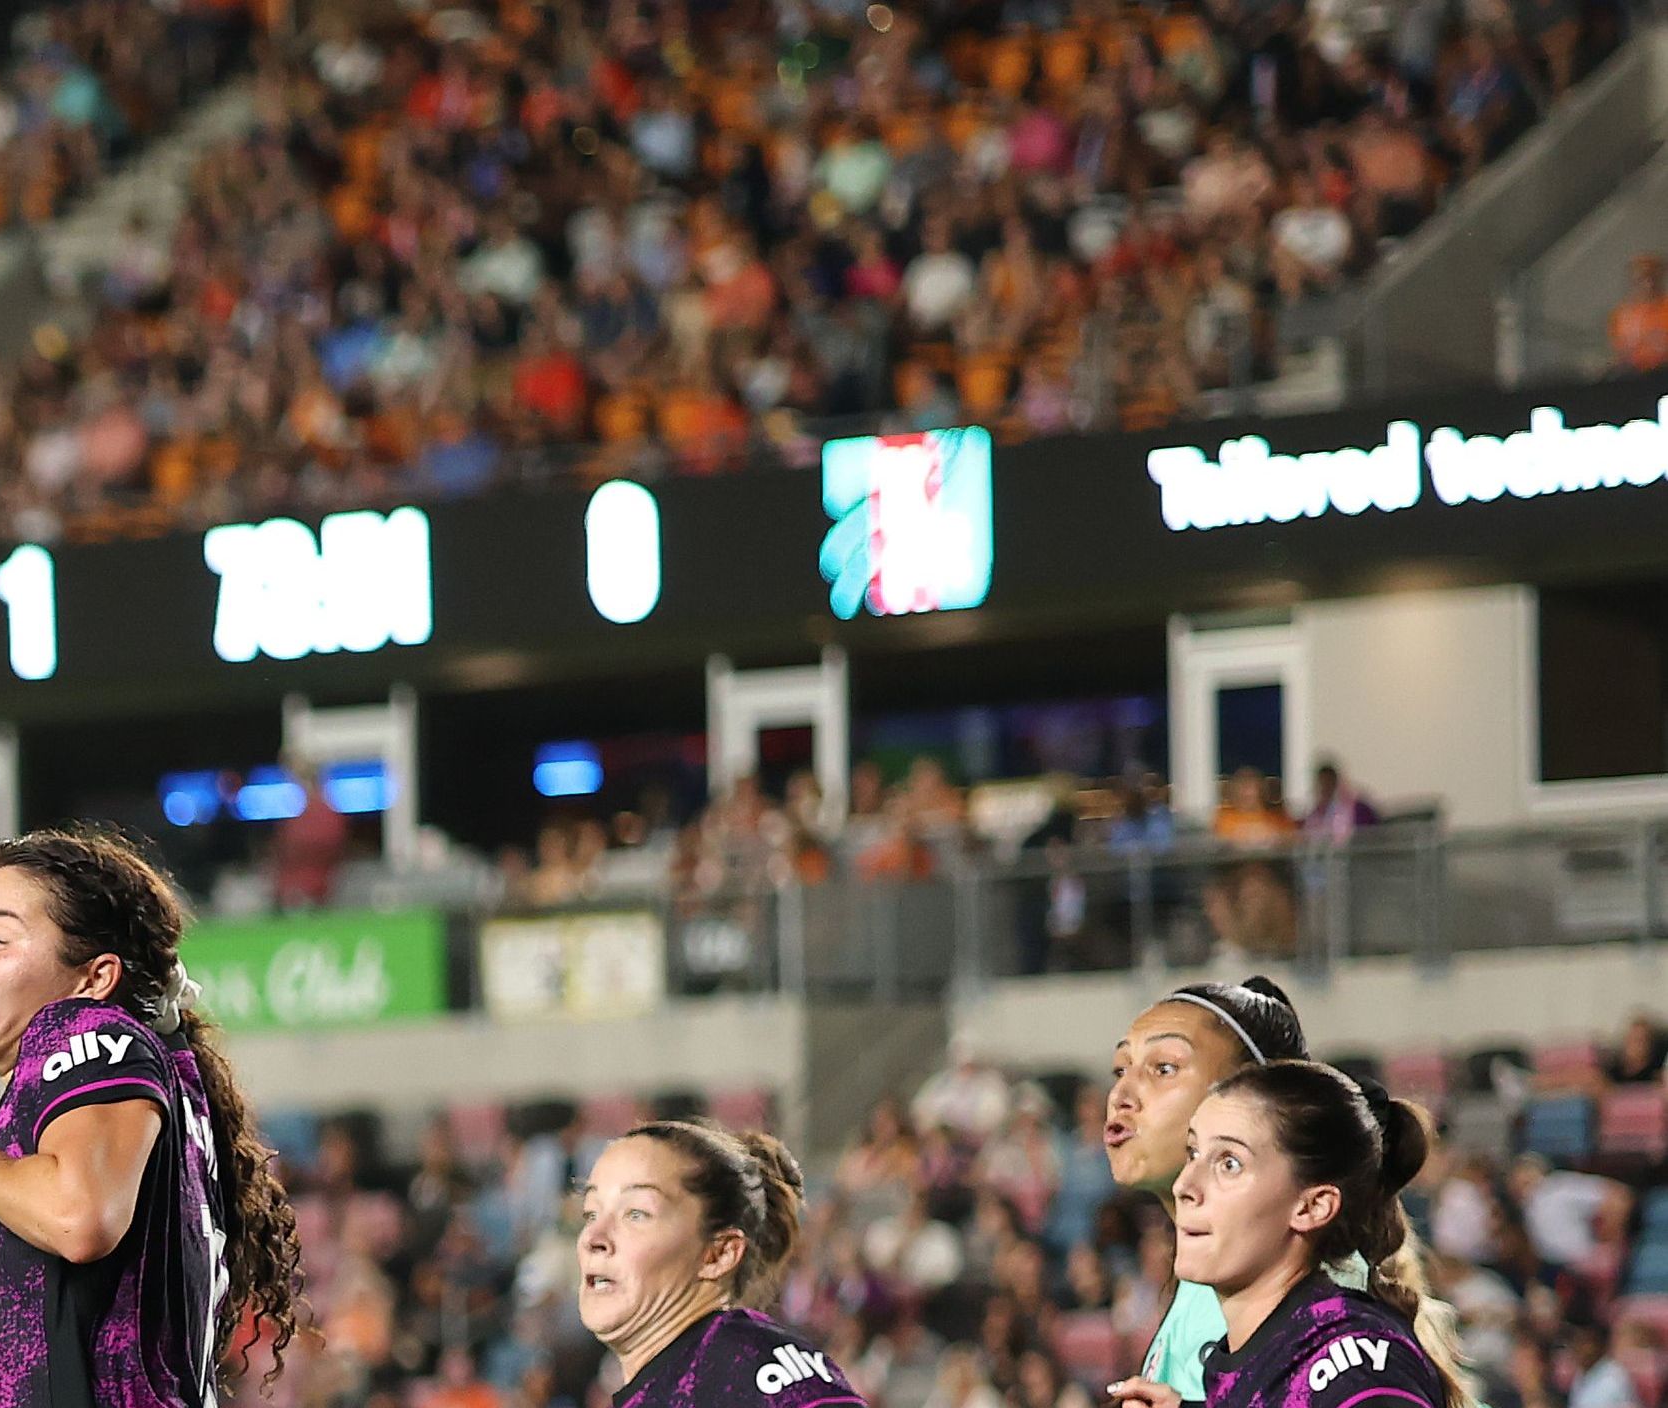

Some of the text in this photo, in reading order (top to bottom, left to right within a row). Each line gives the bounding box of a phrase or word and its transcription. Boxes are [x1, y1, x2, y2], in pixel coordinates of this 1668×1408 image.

[42, 1031, 134, 1082] ally
[755, 1343, 834, 1395] ally
[1308, 1335, 1391, 1392] ally
